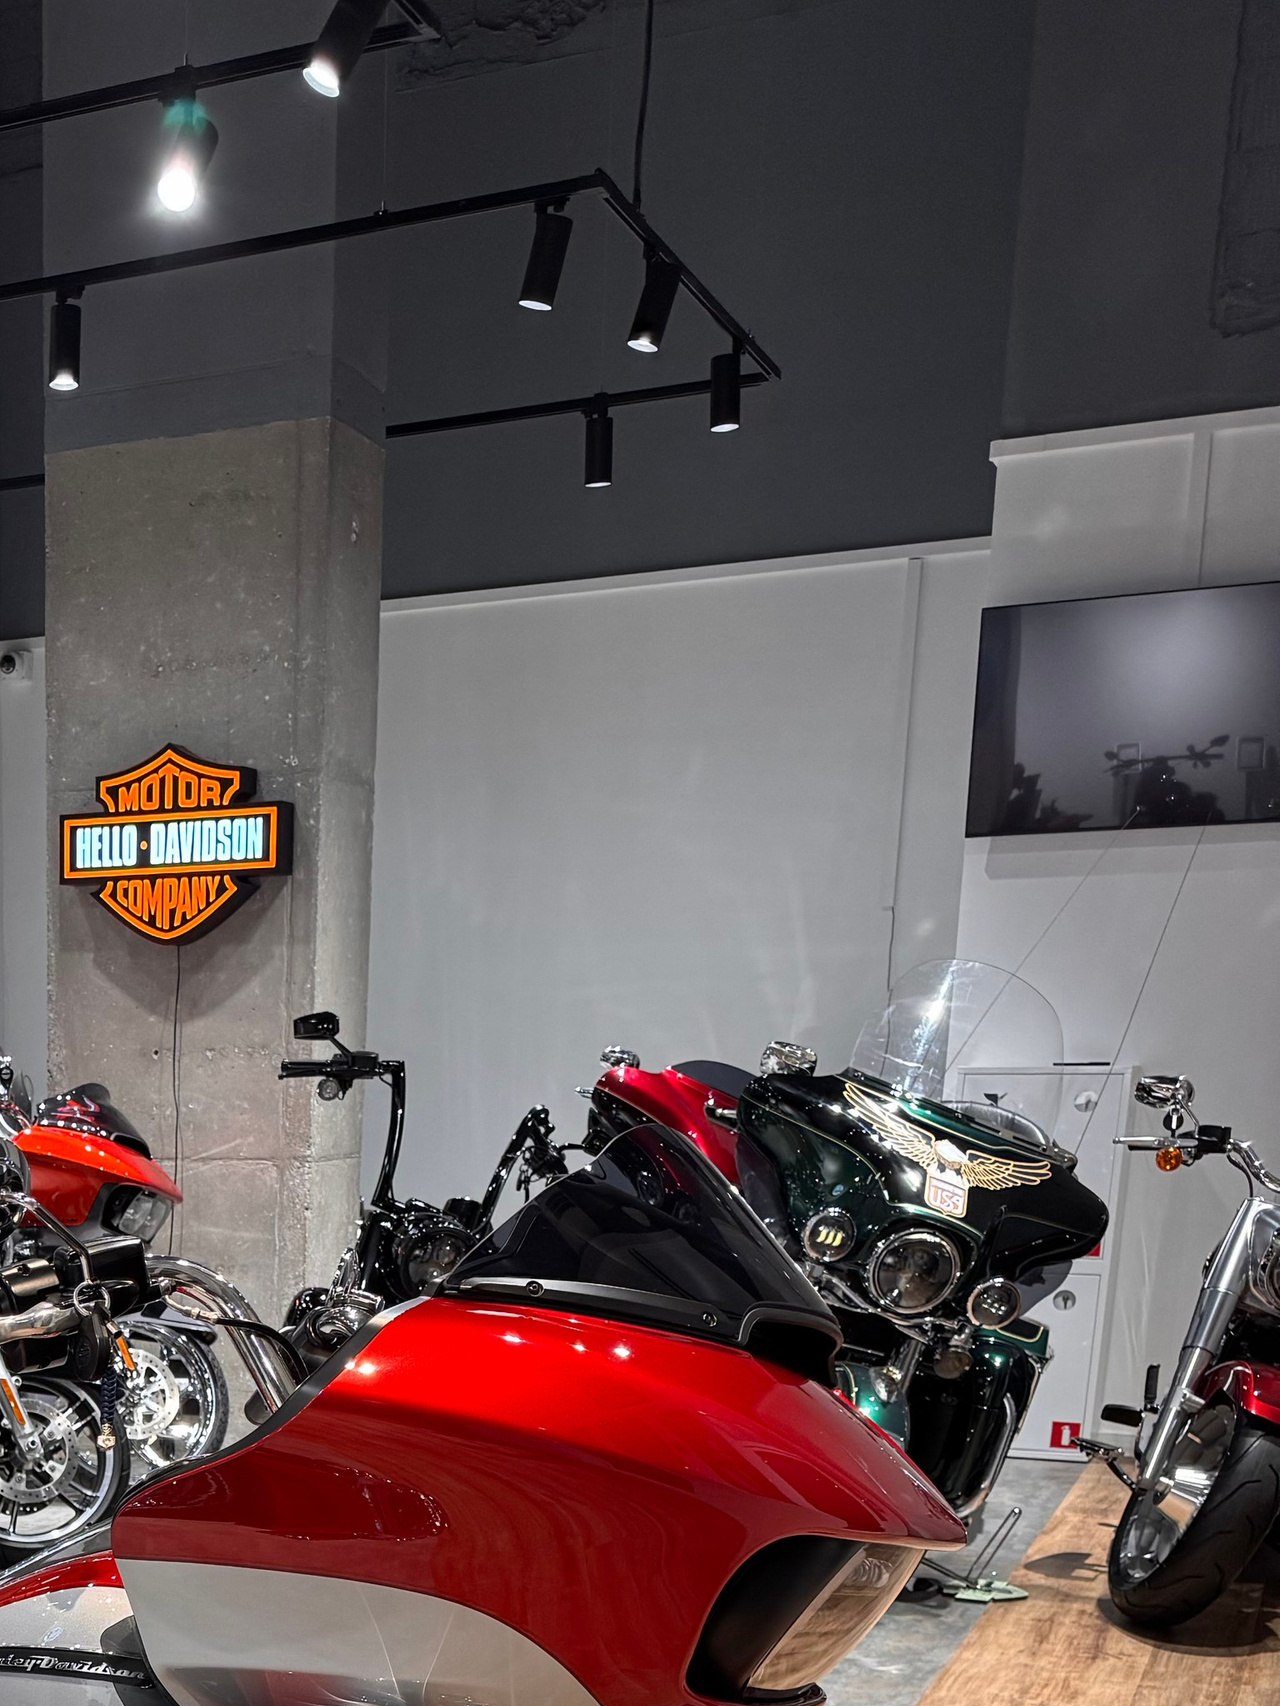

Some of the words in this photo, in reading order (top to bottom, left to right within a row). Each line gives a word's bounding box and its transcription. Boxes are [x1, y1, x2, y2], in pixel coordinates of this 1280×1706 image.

[118, 762, 221, 812] MOTOR
[76, 824, 138, 869] HELLO
[150, 816, 264, 865] DAVIDSON
[116, 875, 221, 930] COMPANY
